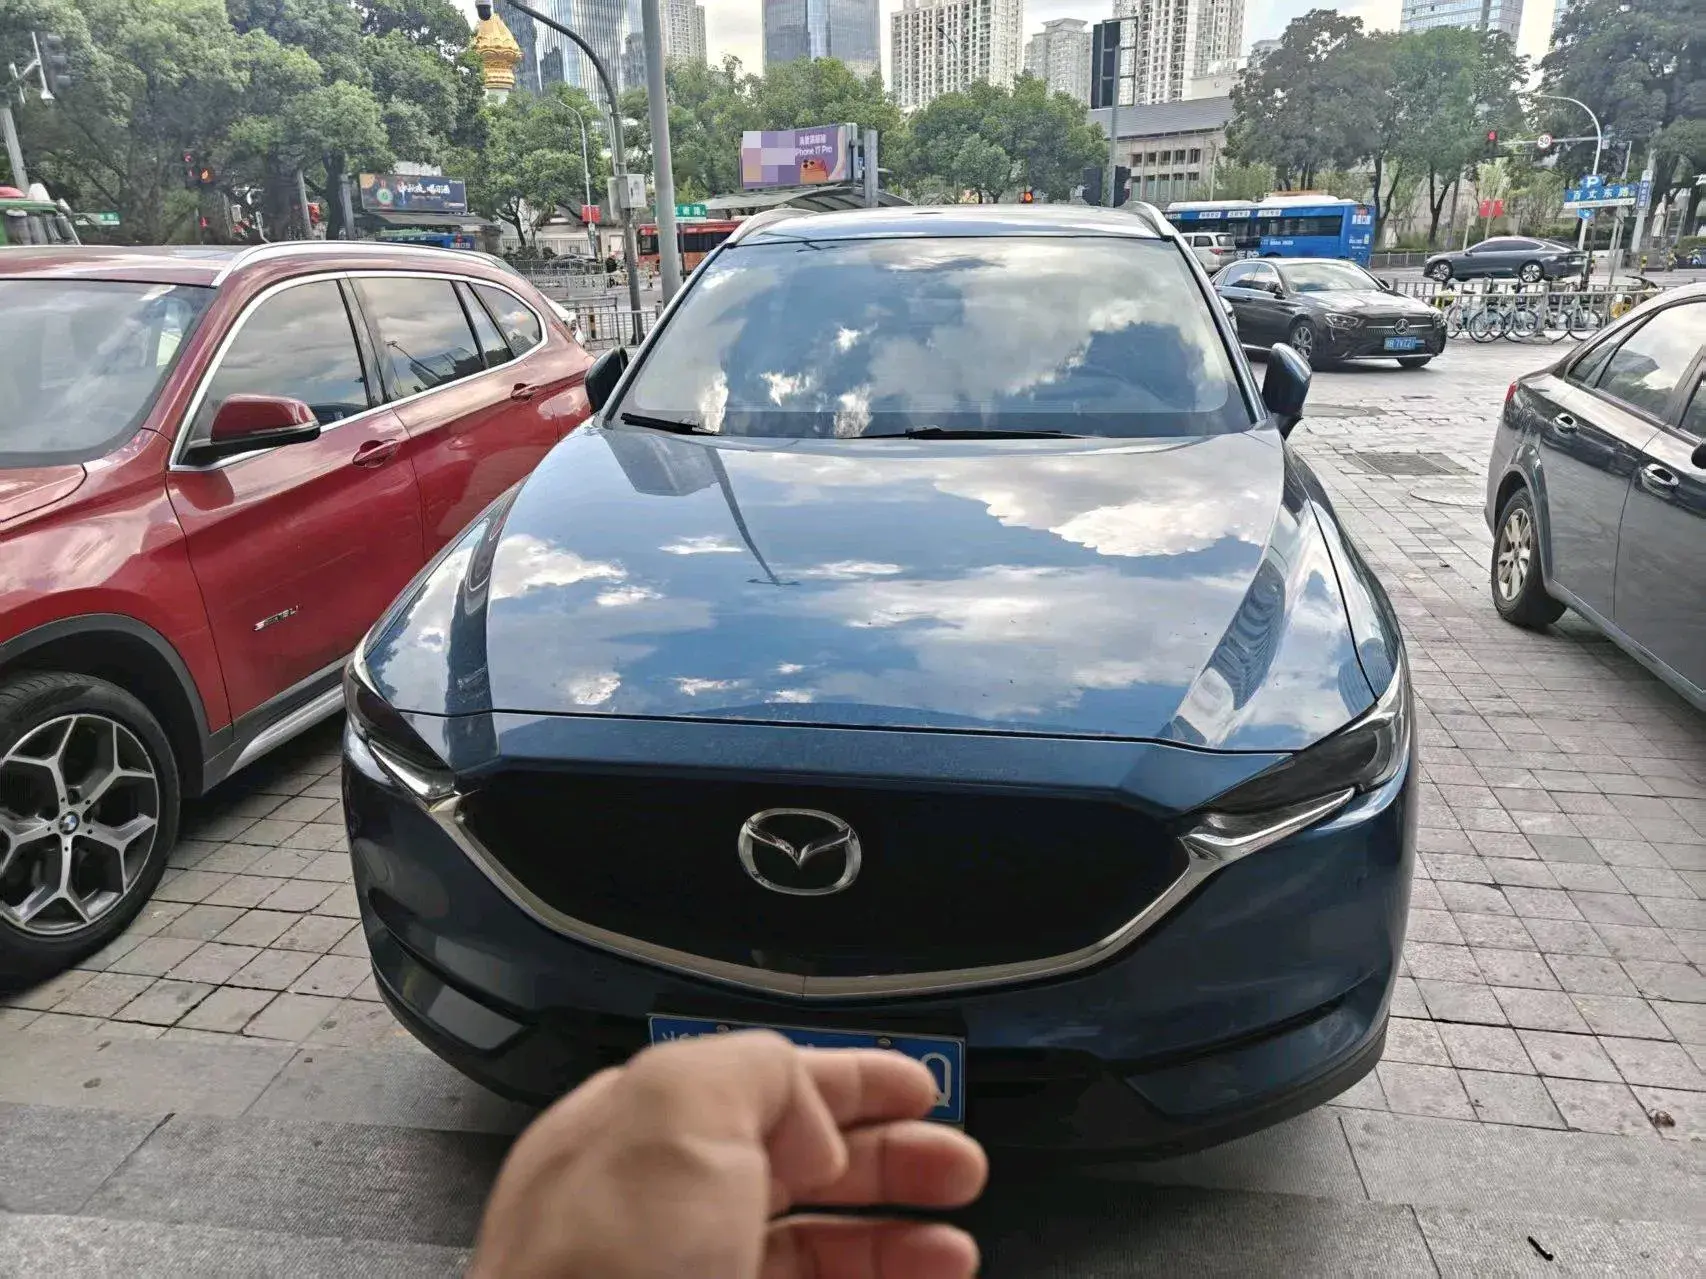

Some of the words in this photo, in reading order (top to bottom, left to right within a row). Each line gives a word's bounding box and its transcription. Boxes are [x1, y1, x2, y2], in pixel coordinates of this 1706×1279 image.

[822, 145, 833, 154] Pro
[1587, 176, 1599, 188] P
[1573, 187, 1629, 200] 百丈东路
